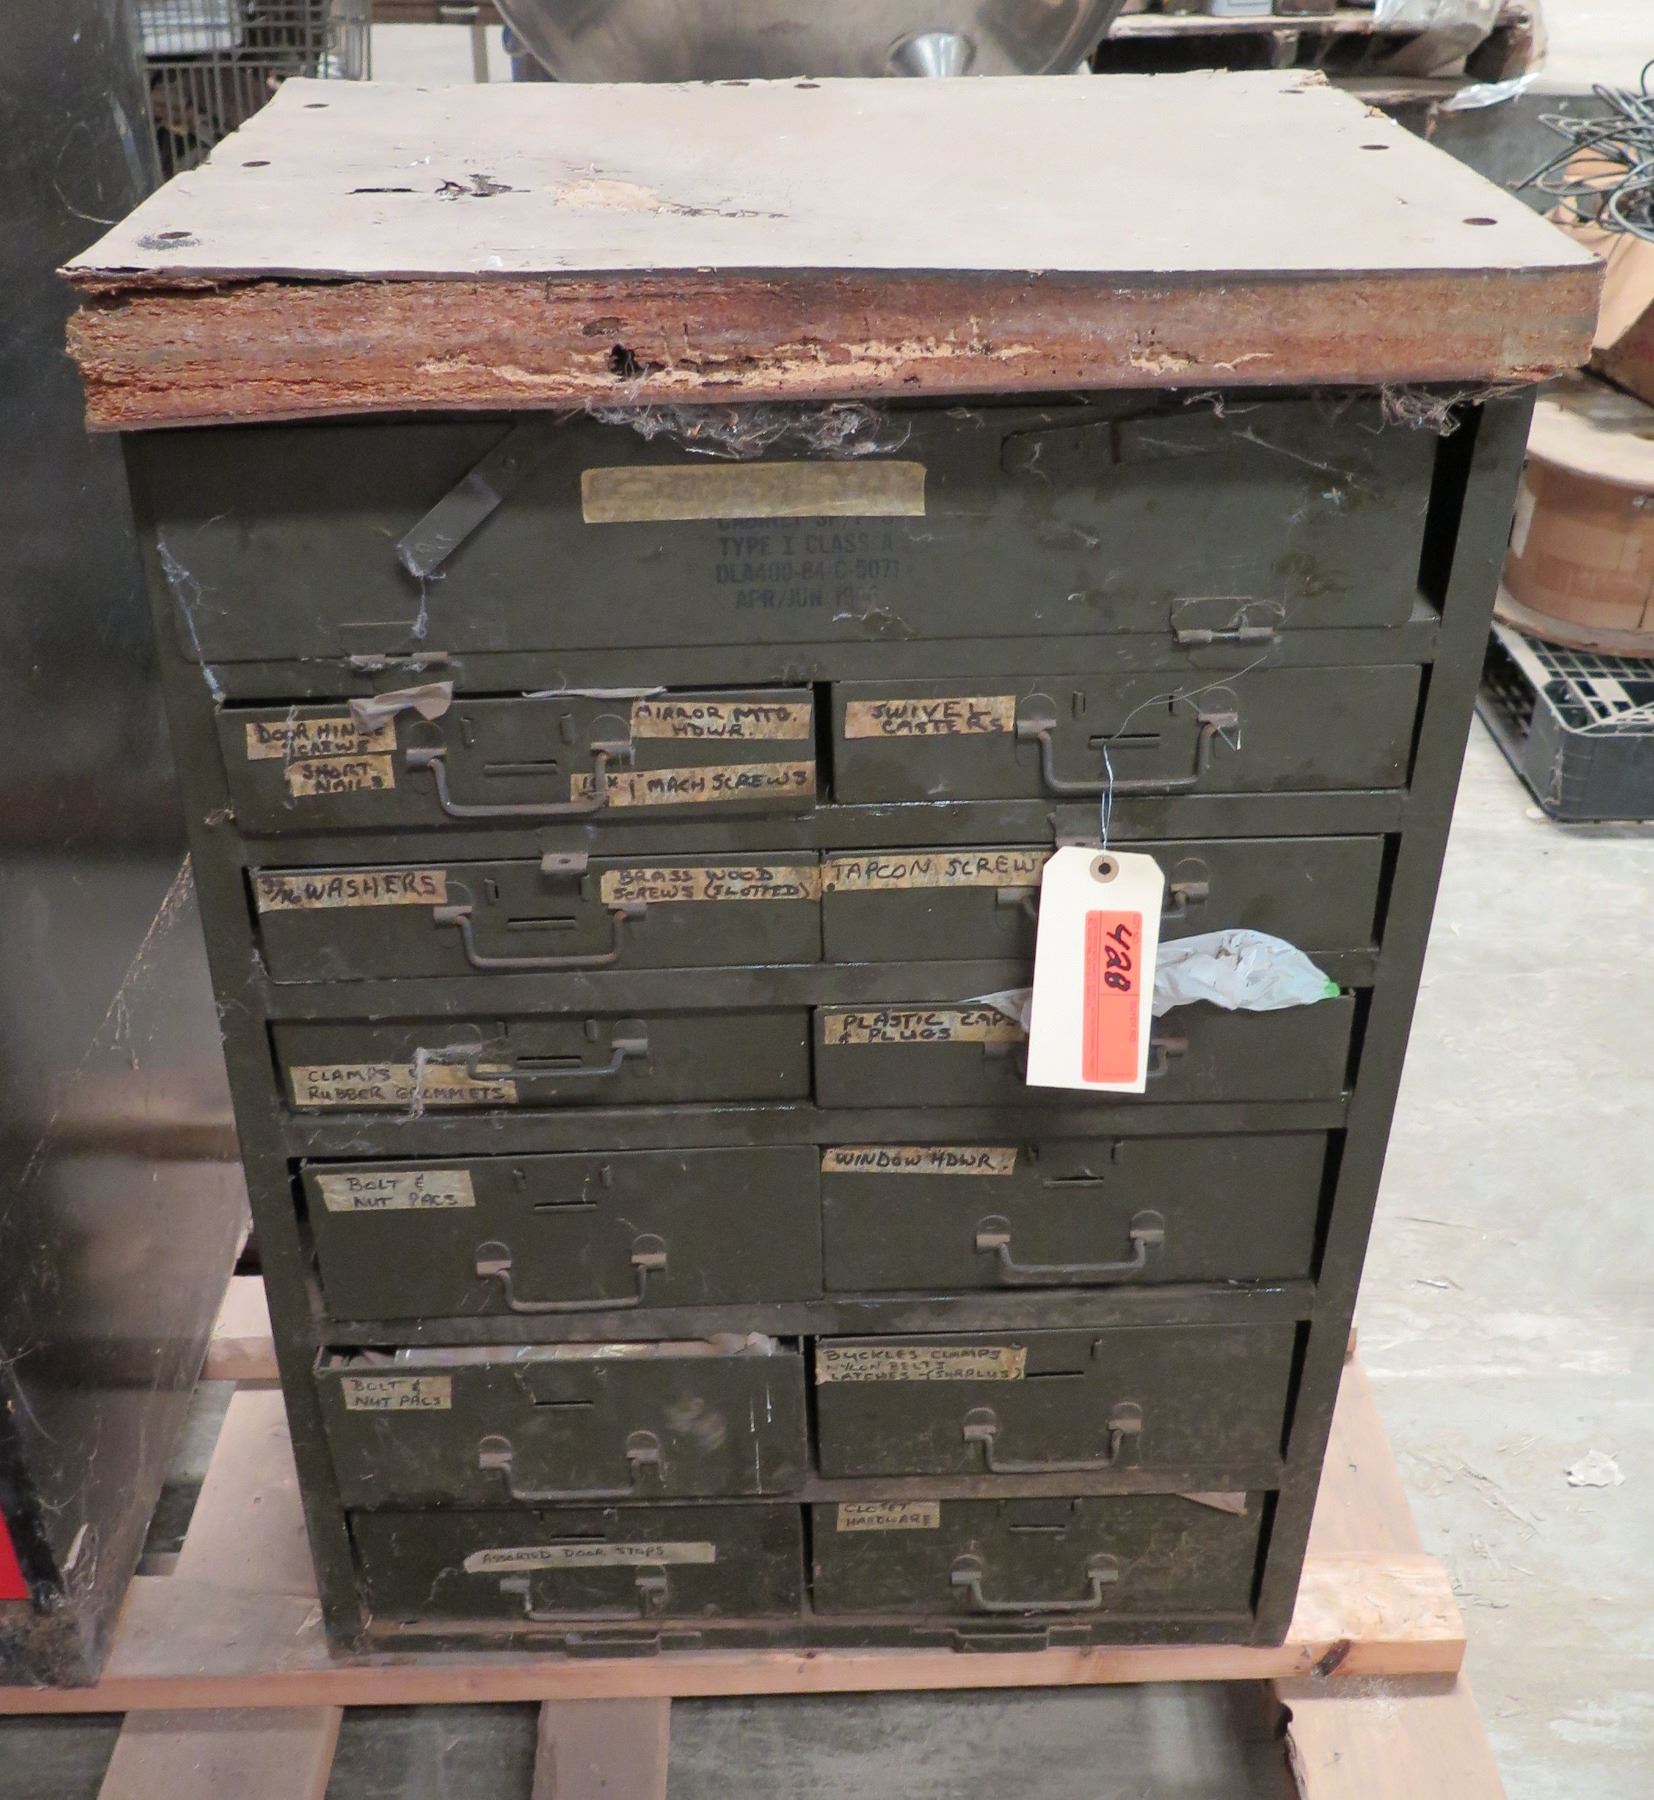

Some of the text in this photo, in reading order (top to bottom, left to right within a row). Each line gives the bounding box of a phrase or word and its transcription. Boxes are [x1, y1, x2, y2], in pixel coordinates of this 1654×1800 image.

[719, 535, 771, 557] TYPE
[635, 705, 724, 721] MIRROR
[871, 702, 991, 719] SWIVEL
[882, 713, 1003, 734] CASTERS
[255, 722, 309, 743] DOOR
[302, 763, 368, 780] SHORT
[314, 776, 383, 793] NAILS
[647, 774, 706, 794] MACH
[712, 770, 808, 790] SCREWS
[619, 867, 773, 884] BRASS WOOD
[832, 856, 1049, 880] TAPCON SCREW
[304, 872, 436, 899] WASHERS
[613, 885, 694, 900] SCREWS
[1104, 923, 1132, 992] 428
[843, 1010, 944, 1030] PLASTIC
[868, 1027, 950, 1042] PLUGS
[308, 1086, 383, 1100] RUBBER
[834, 1152, 920, 1168] WINDOW
[347, 1176, 399, 1191] BOLT
[354, 1192, 458, 1208] NUT PACS
[824, 1349, 918, 1361] BUCKLES
[351, 1379, 402, 1392] BOLT
[355, 1396, 392, 1407] NUT
